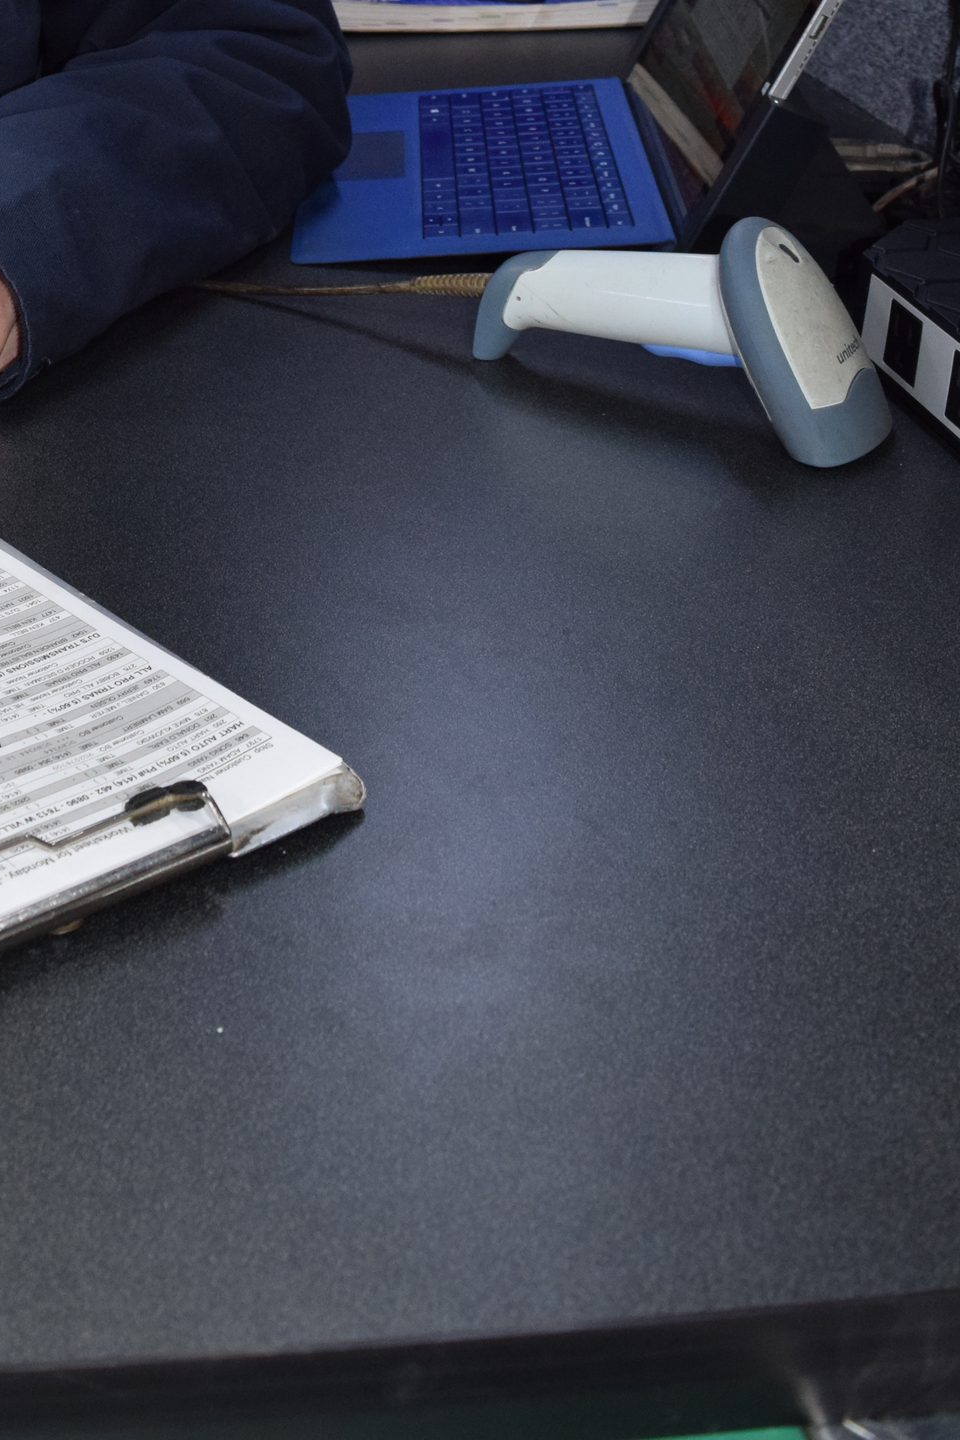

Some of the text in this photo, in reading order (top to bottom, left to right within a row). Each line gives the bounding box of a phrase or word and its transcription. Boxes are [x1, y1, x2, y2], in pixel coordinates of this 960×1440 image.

[5, 642, 80, 674] TRANSMISSIONS
[133, 664, 153, 675] ALL
[113, 674, 135, 686] PRO
[81, 684, 114, 700] TRNAS
[218, 720, 244, 737] HART
[190, 734, 217, 751] AUTO
[112, 774, 138, 786] (414)
[23, 815, 36, 824] W
[72, 826, 132, 852] Worksheet
[55, 849, 73, 859] for
[5, 856, 55, 878] Monday,
